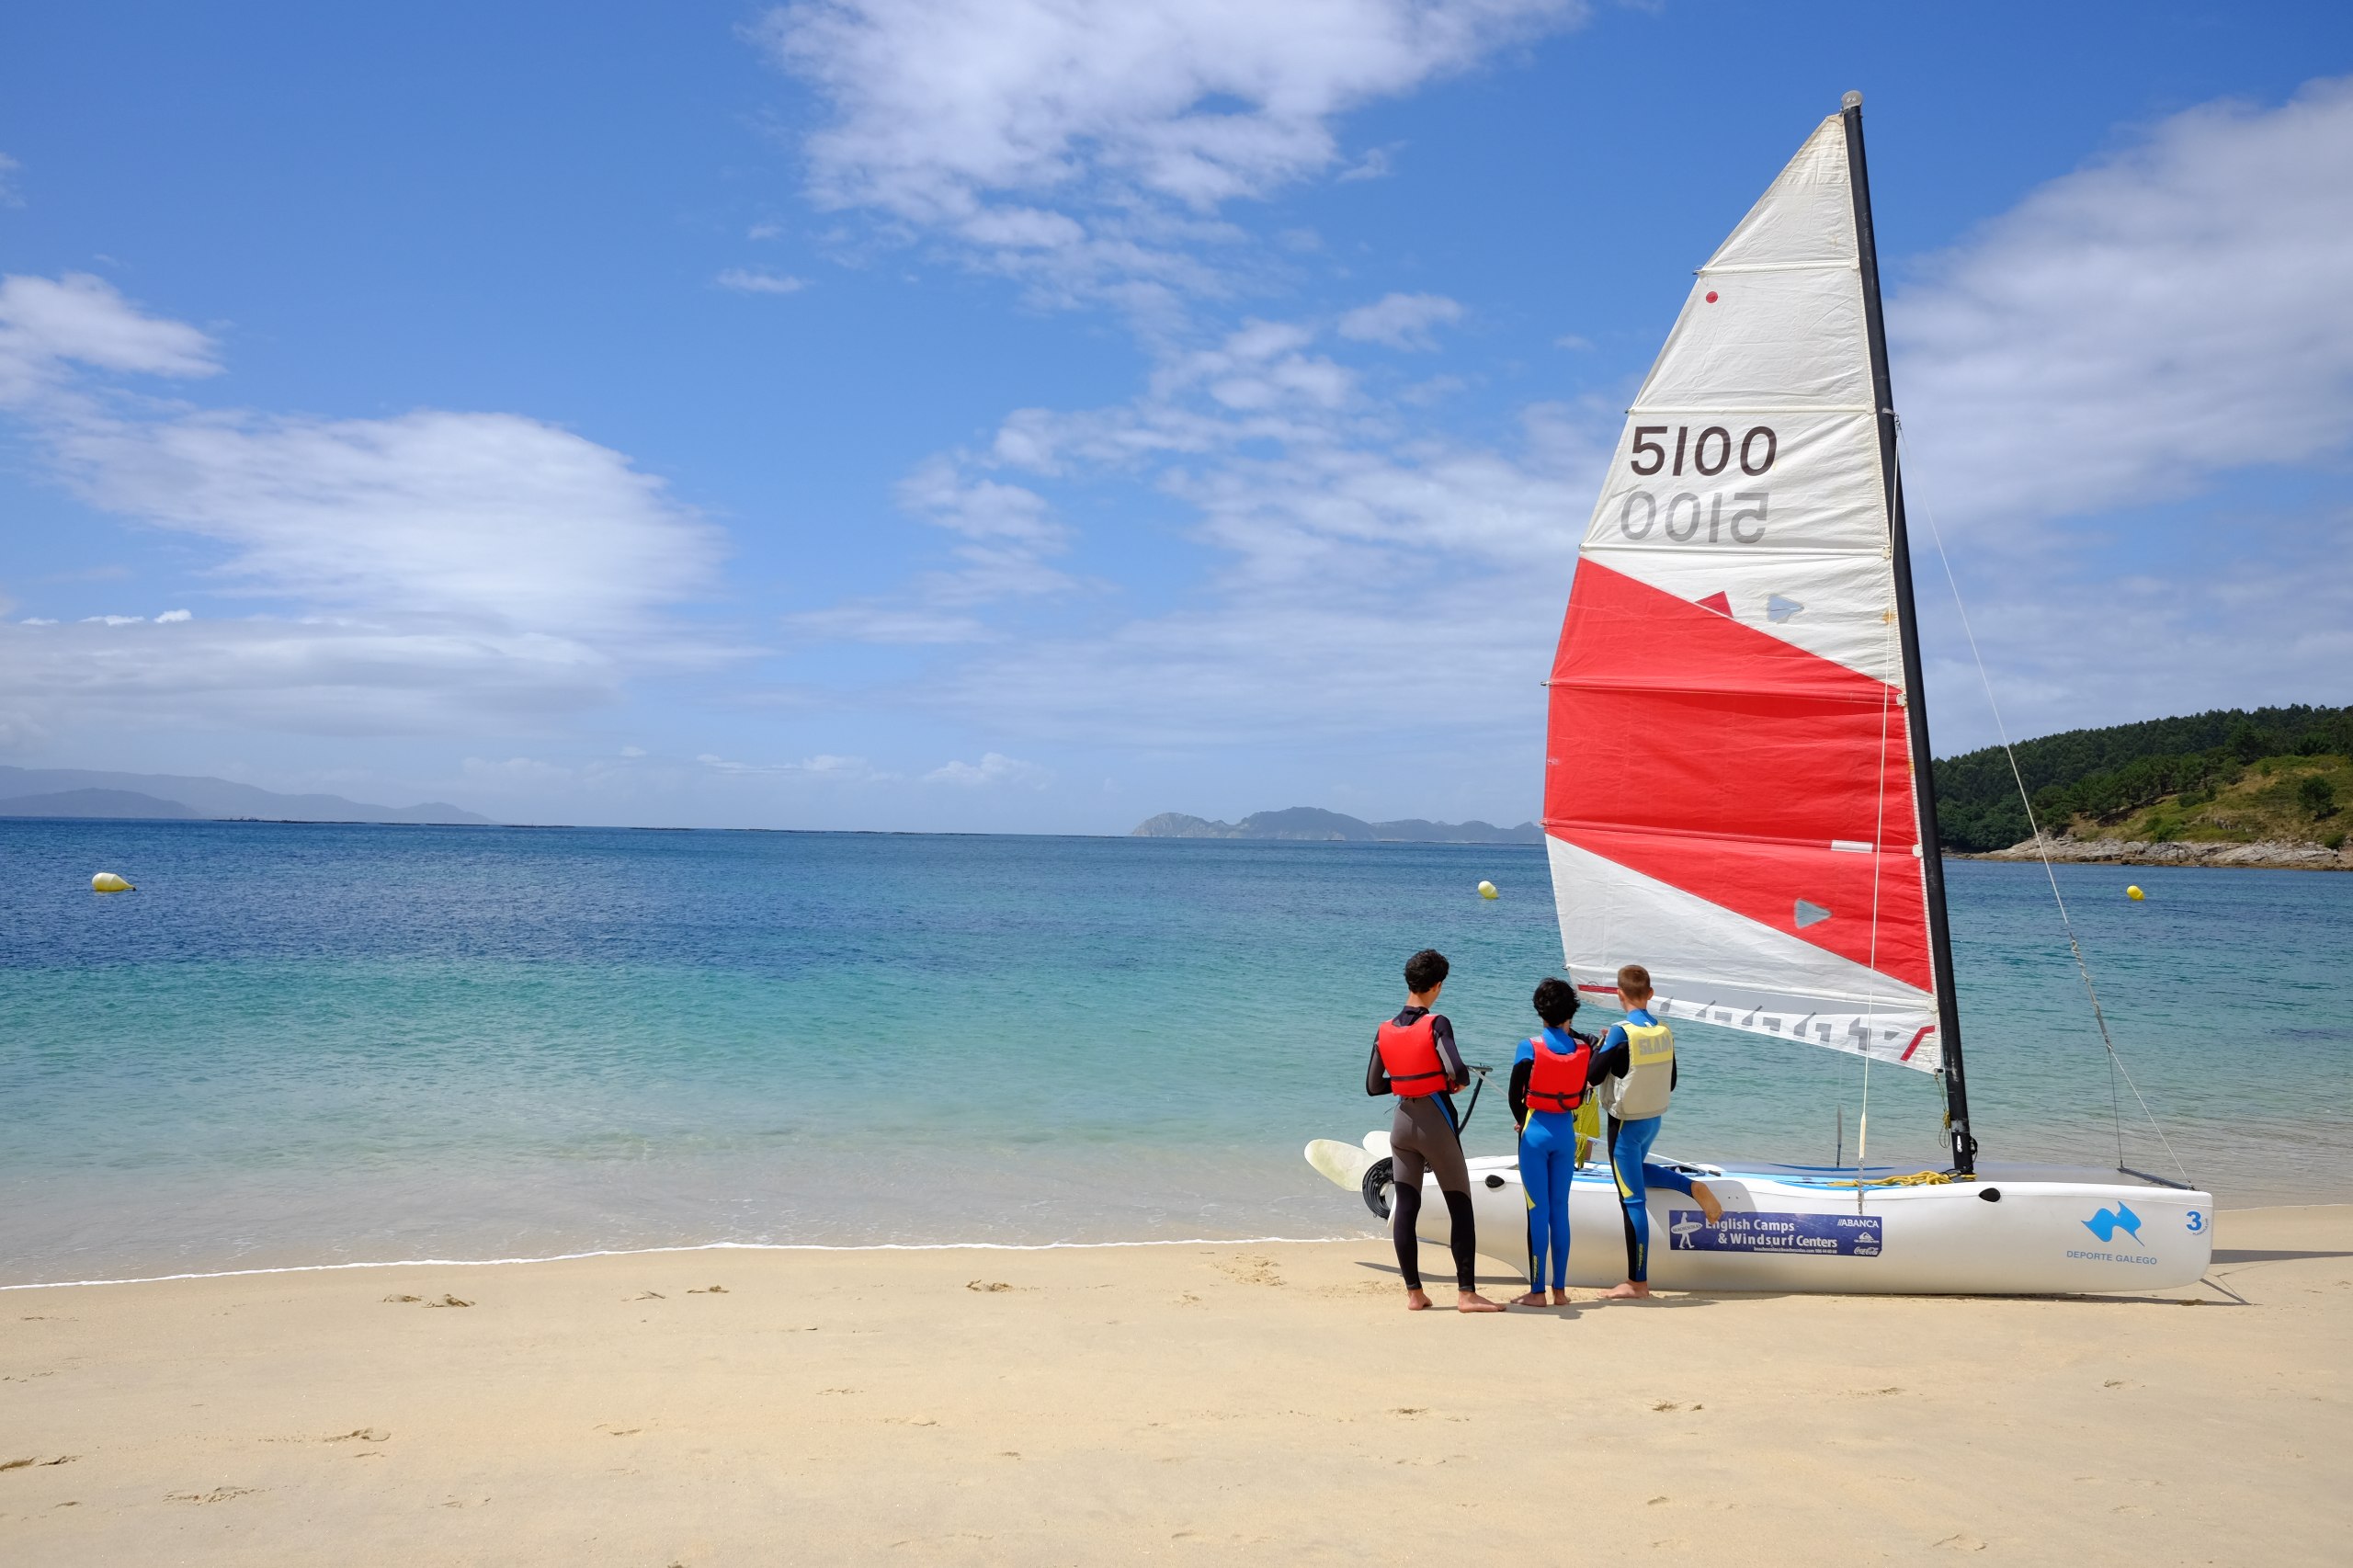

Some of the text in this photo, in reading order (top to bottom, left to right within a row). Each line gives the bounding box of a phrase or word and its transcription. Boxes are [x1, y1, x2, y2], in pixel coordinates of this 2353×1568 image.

[1631, 426, 1778, 477] 5100
[1639, 1035, 1671, 1056] SLAM
[1705, 1218, 1795, 1233] English Camps
[2186, 1210, 2202, 1232] 3
[1718, 1233, 1837, 1248] & Windsurf Centers
[2066, 1250, 2157, 1265] DEPORTE GALEGO
